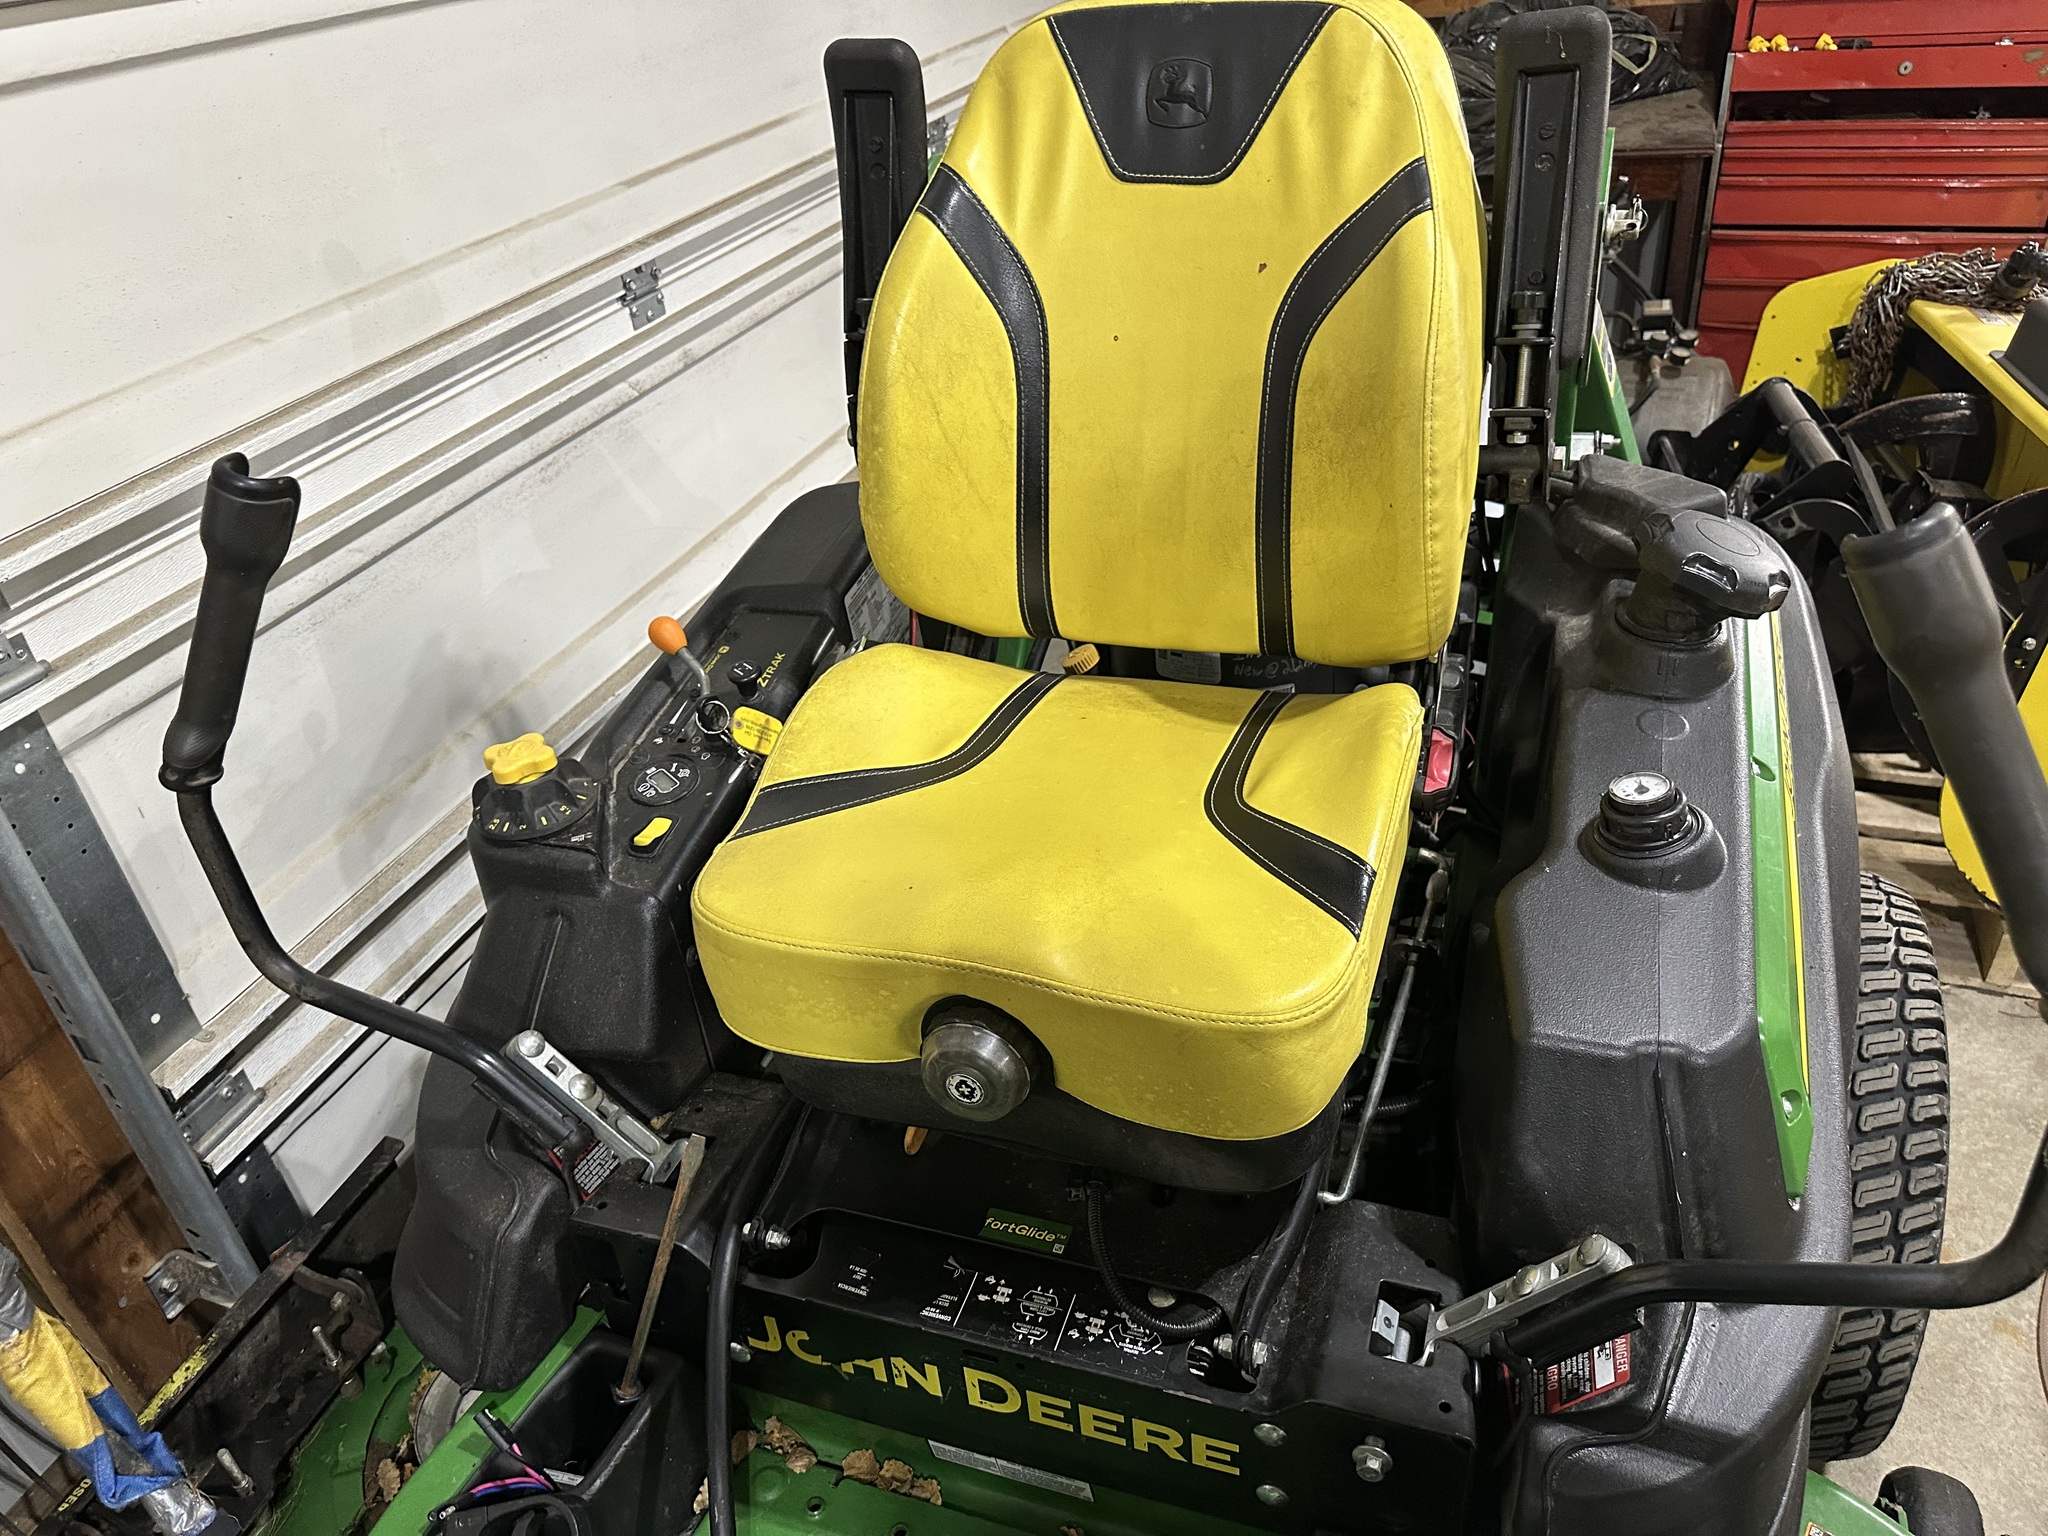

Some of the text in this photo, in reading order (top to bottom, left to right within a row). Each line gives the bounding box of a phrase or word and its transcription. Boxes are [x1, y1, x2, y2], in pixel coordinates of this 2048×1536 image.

[756, 652, 786, 688] ZTRAK
[1614, 1338, 1628, 1373] ANGER
[1546, 1364, 1558, 1390] IGRO
[963, 1366, 1241, 1477] DEERE
